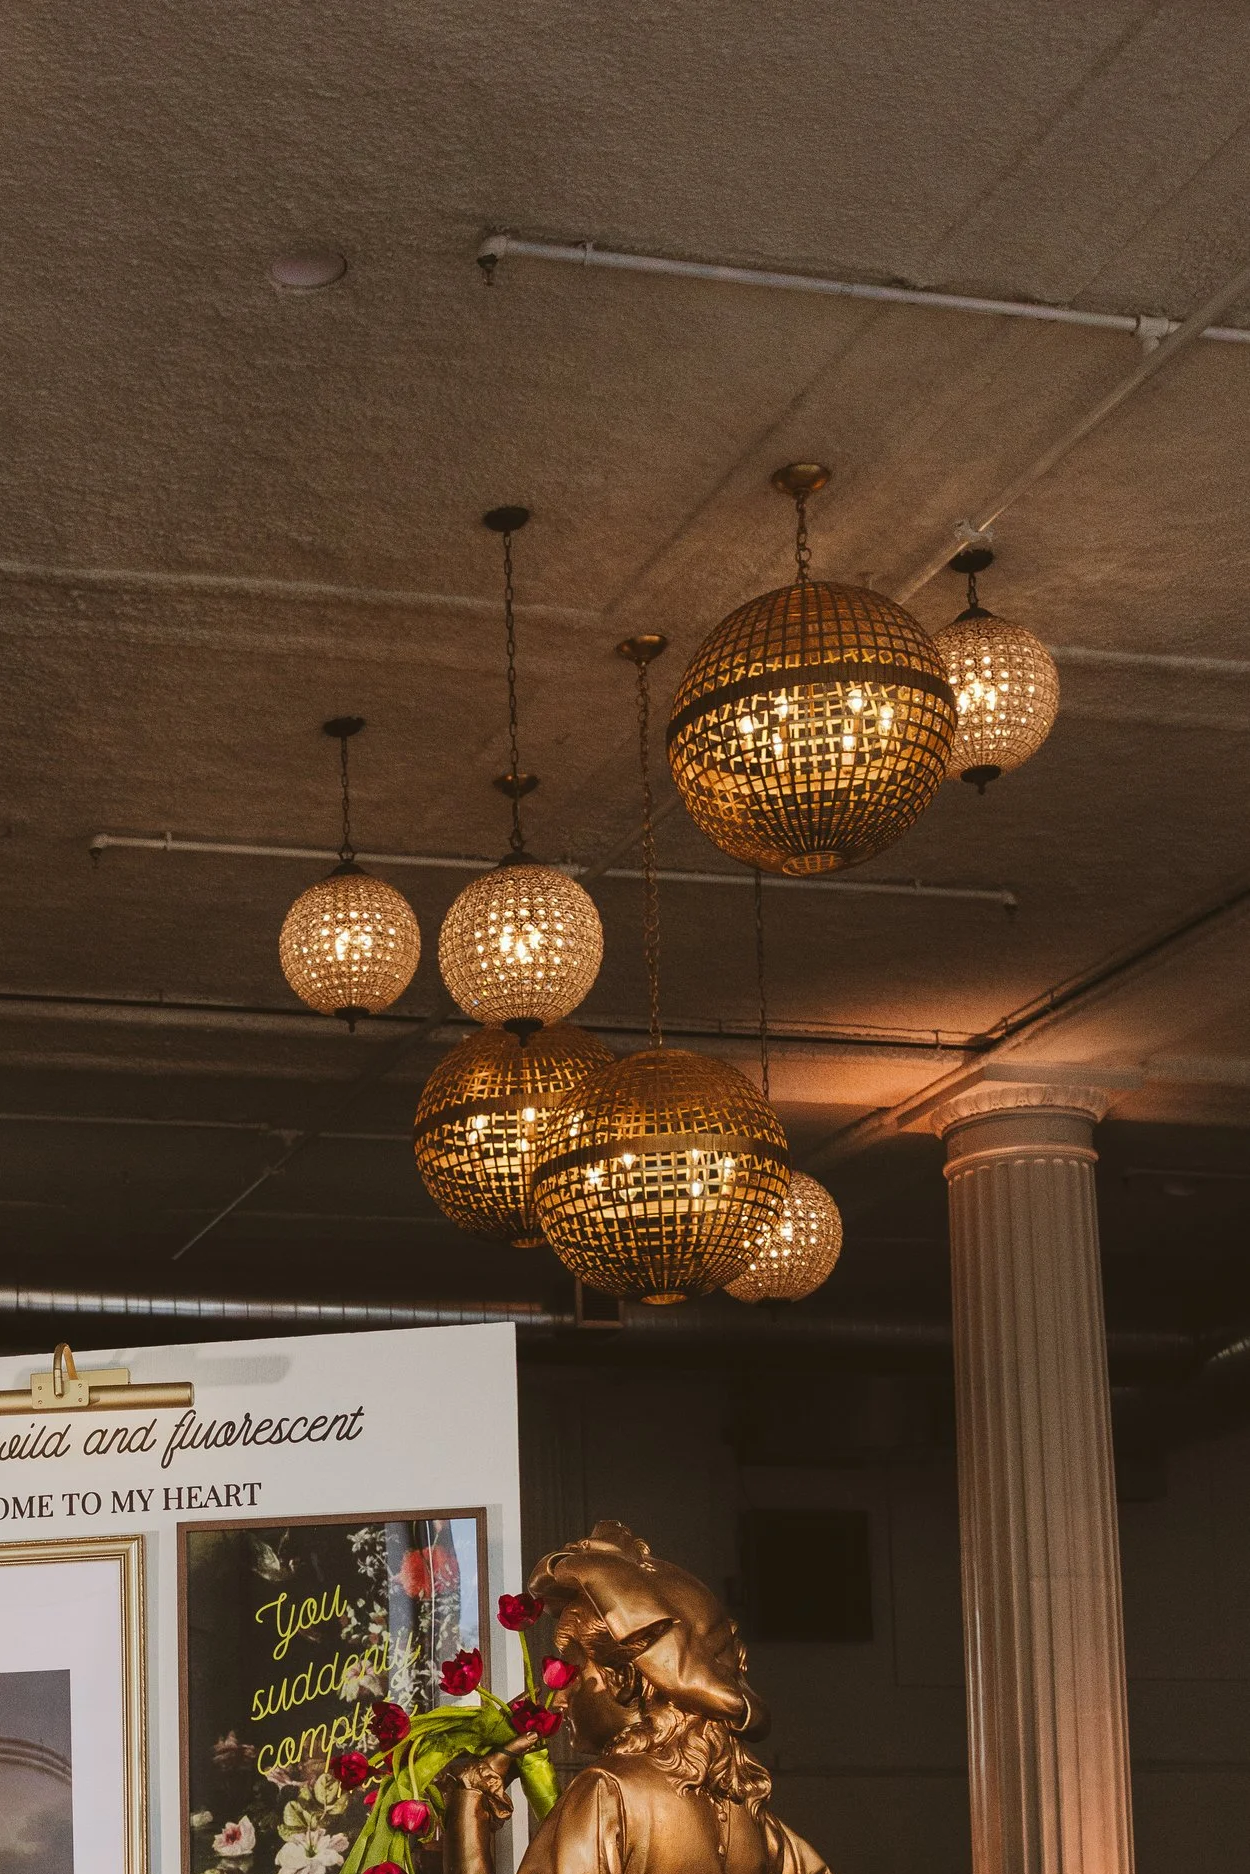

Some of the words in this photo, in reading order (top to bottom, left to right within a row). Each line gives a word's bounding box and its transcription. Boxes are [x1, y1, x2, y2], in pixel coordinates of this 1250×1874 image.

[83, 1418, 158, 1456] and
[161, 1405, 365, 1470] fluorescent
[62, 1491, 102, 1517] TO
[111, 1488, 155, 1514] MY
[163, 1482, 262, 1511] HEART
[255, 1584, 348, 1661] You
[251, 1631, 422, 1721] suddenly
